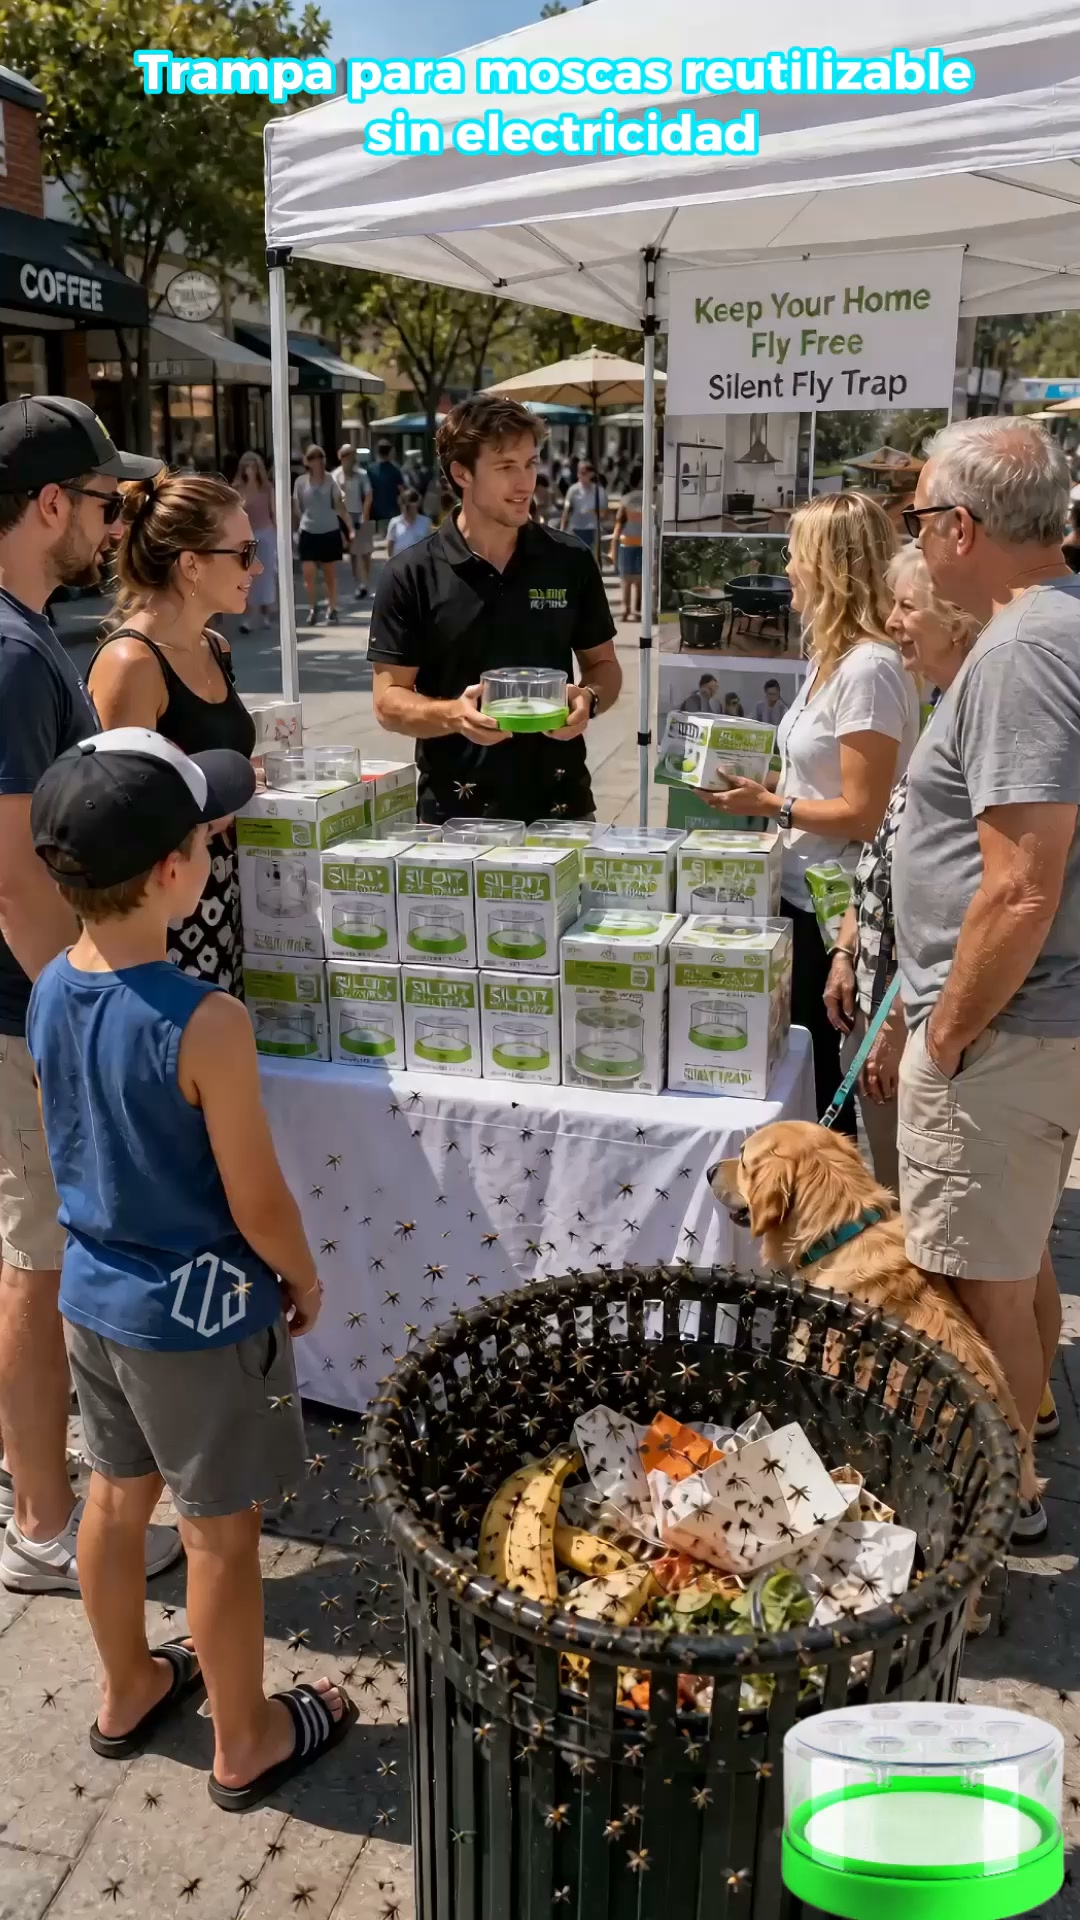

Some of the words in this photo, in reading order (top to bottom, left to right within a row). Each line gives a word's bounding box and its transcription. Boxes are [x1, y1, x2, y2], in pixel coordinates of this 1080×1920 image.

[20, 263, 103, 311] COFFEE
[695, 296, 762, 327] Keep
[771, 291, 835, 317] Your
[843, 285, 931, 314] Home
[751, 330, 791, 364] Fly
[800, 329, 863, 356] Free
[708, 373, 783, 400] Silent
[792, 371, 833, 403] Fly
[841, 369, 908, 401] Trap
